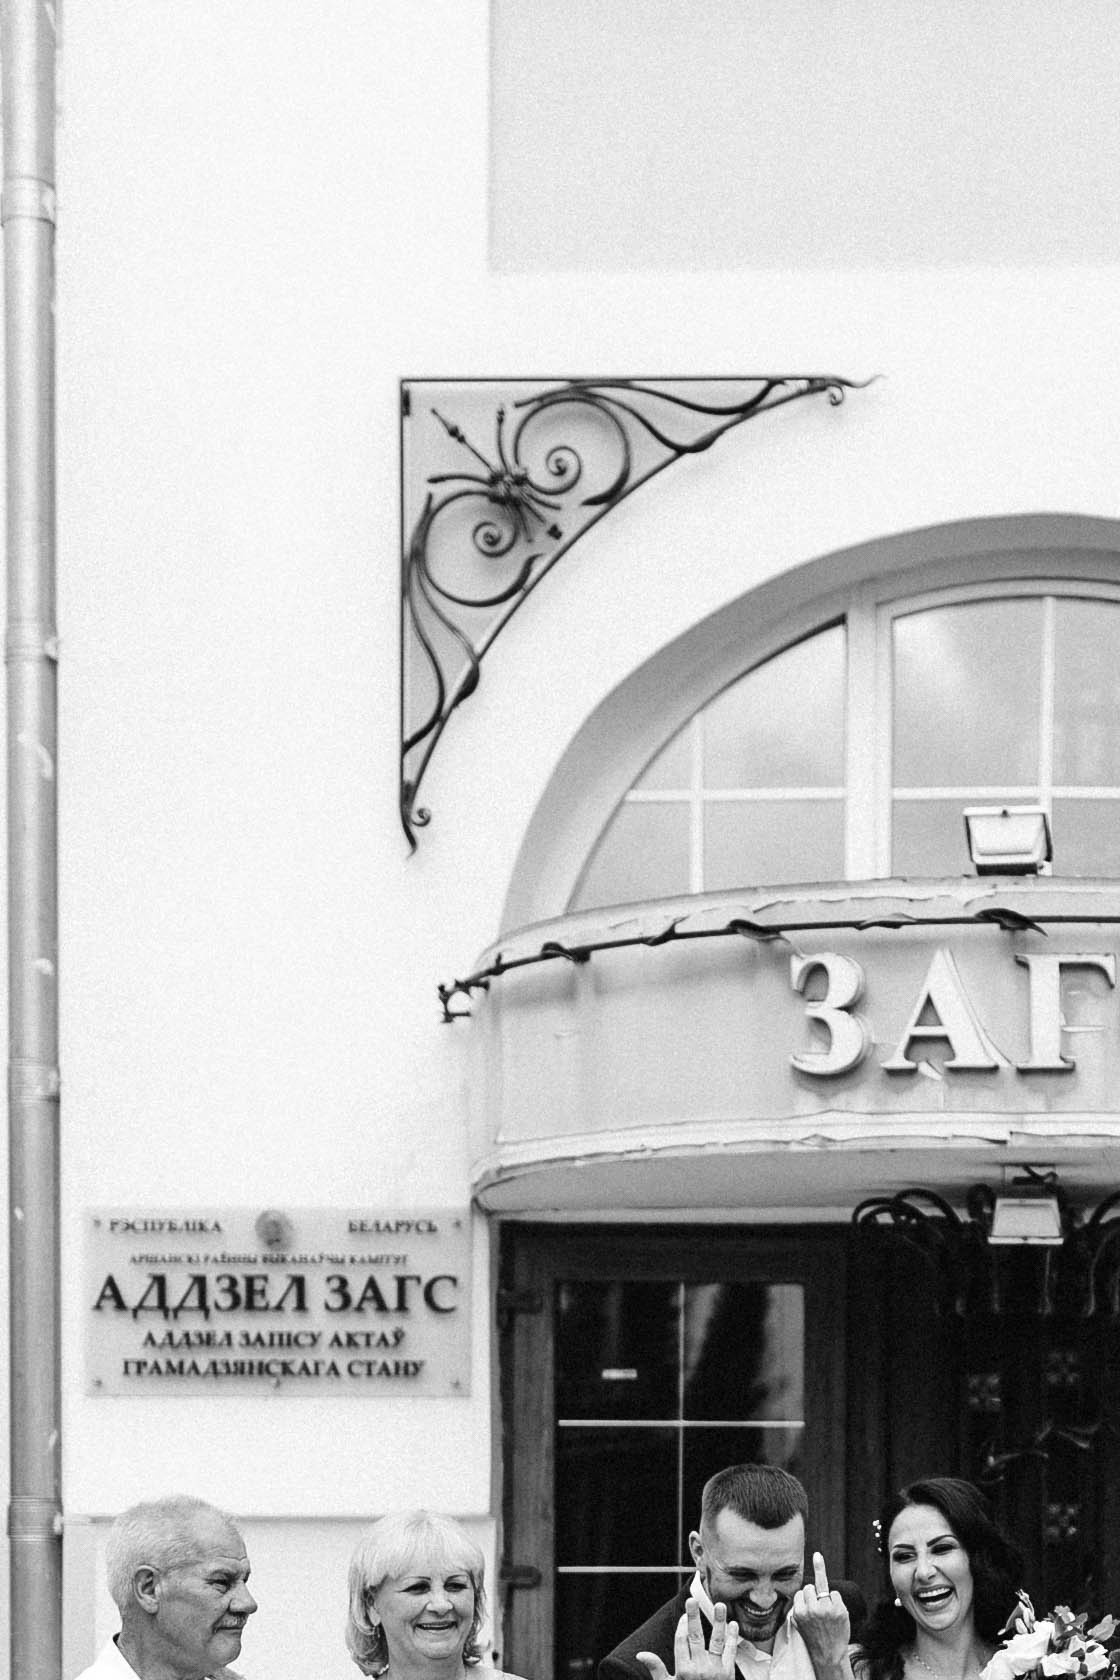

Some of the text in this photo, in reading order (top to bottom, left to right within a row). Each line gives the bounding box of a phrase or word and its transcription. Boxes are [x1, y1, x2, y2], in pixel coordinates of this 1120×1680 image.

[109, 1218, 438, 1234] РЭСПУБЛІКА БЕЛАРУСЬ
[93, 1273, 458, 1321] АДДЗЕЛ ЗАГС
[143, 1326, 406, 1350] АДДЗЕЛ ЗАПІСУ АКТАЎ
[123, 1359, 425, 1379] ГРАМАДЗЯНСКАГА СТАНУ
